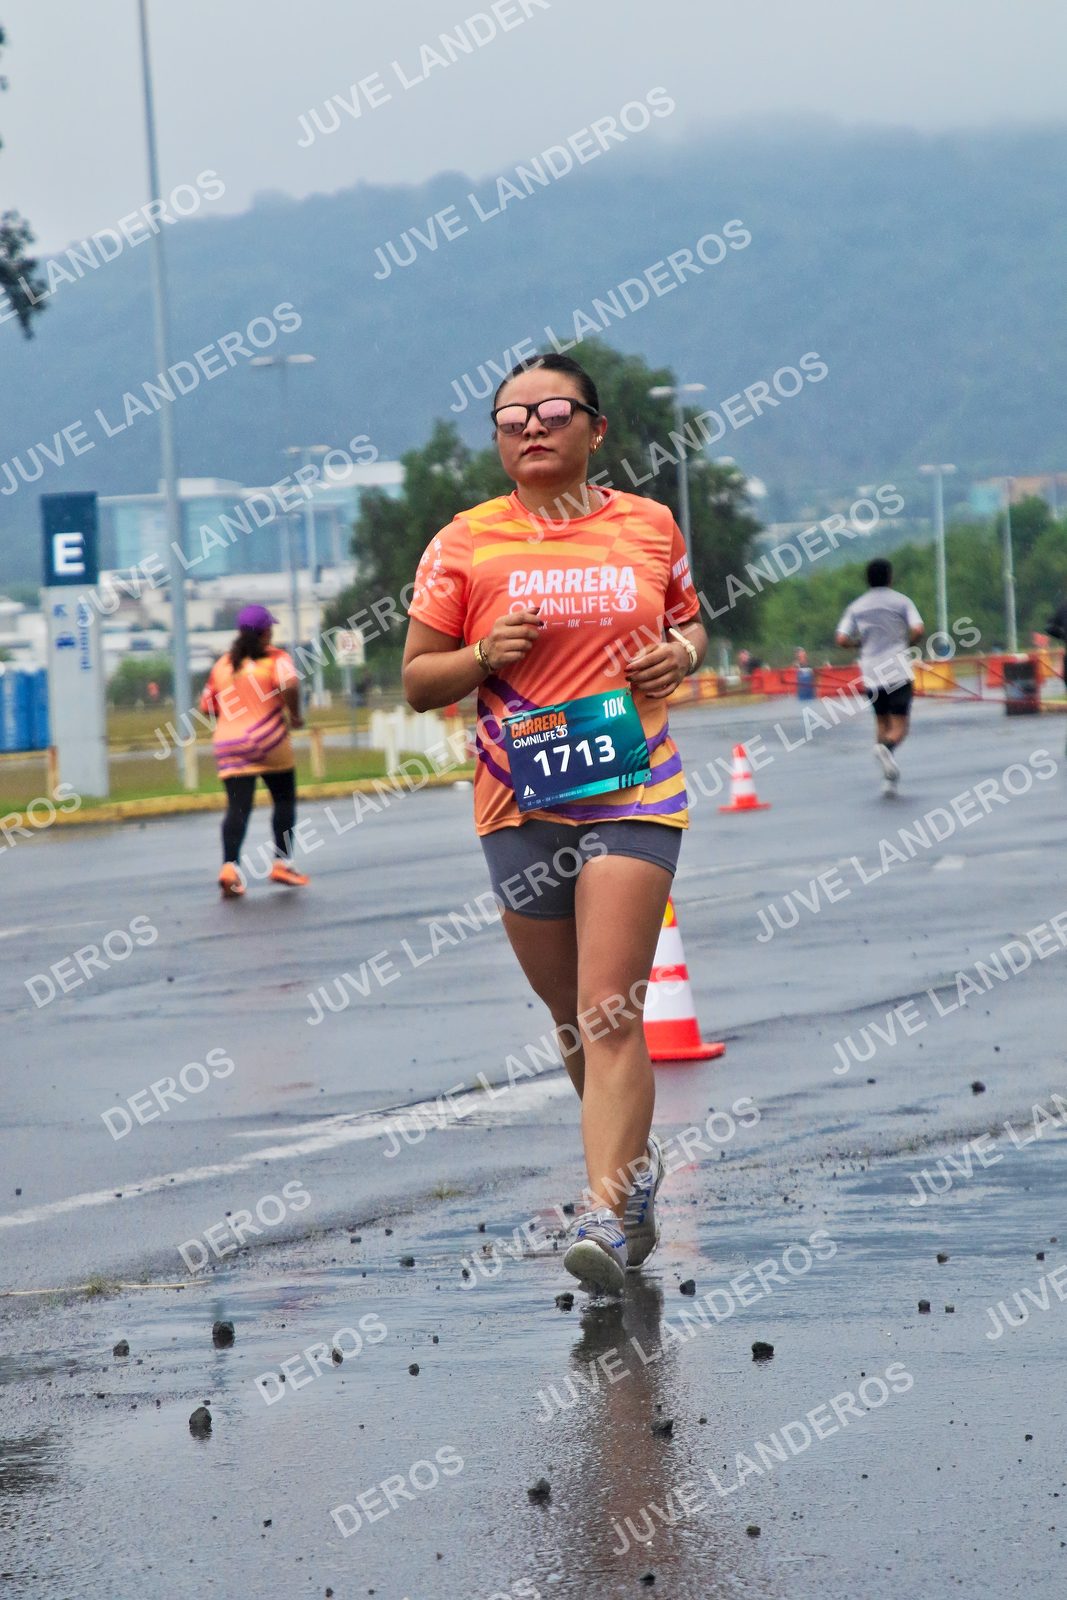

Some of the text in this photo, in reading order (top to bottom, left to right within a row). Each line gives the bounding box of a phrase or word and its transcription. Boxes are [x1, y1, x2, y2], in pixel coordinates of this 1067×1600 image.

[53, 532, 86, 576] E
[508, 566, 638, 598] CARRERA
[602, 696, 627, 719] 10K
[510, 711, 567, 739] CARRERA
[513, 731, 557, 749] OMNILIFE
[533, 735, 616, 777] 1713
